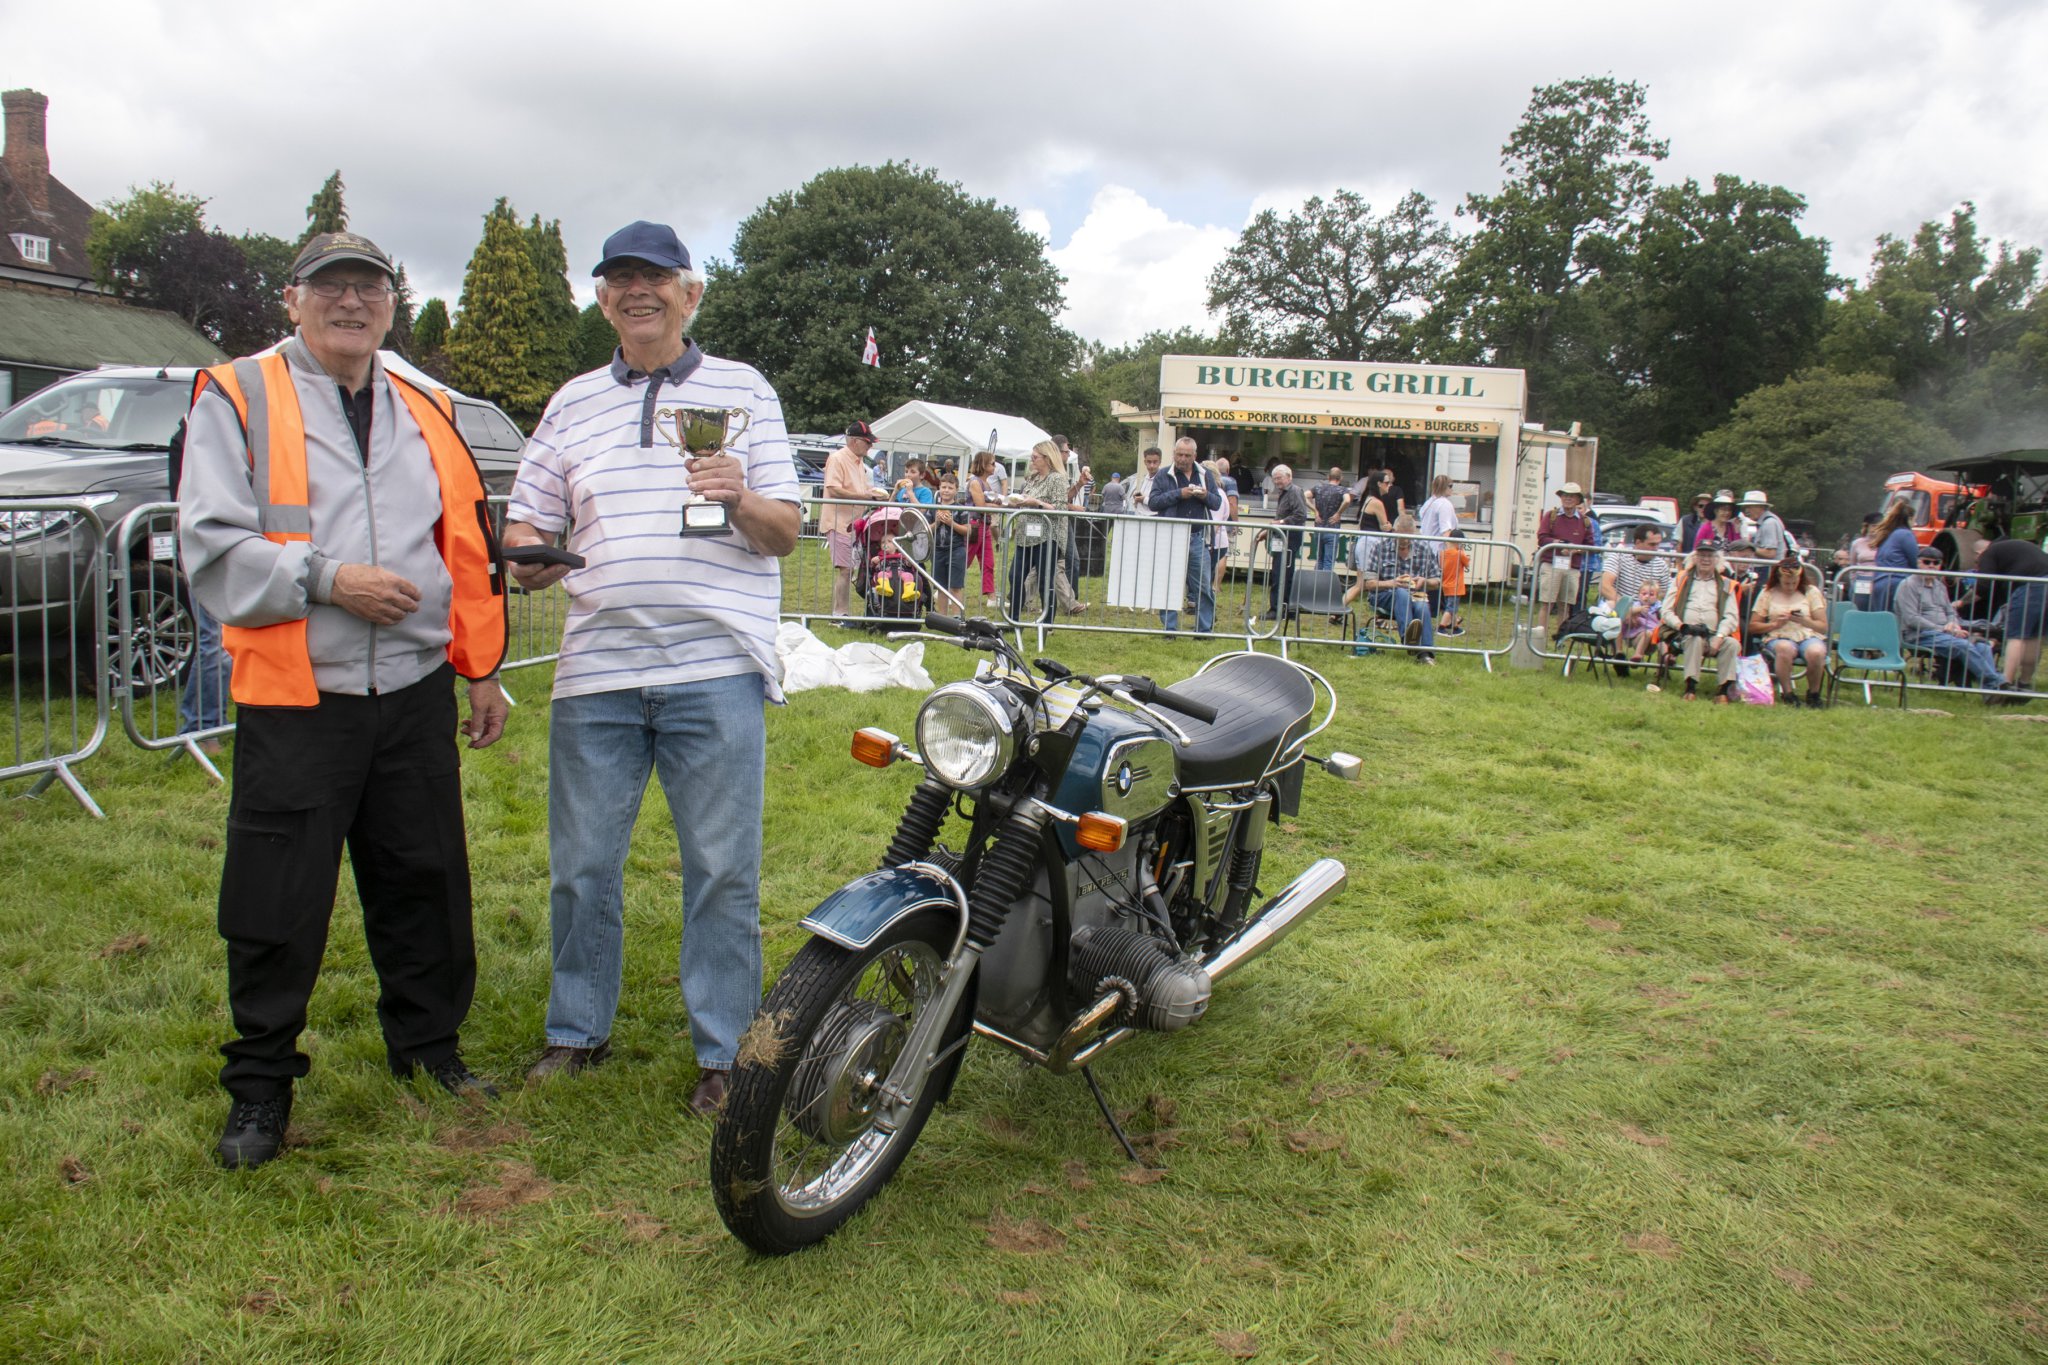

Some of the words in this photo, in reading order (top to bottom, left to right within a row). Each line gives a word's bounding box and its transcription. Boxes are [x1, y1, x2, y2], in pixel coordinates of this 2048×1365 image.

[1196, 365, 1354, 391] BURGER
[1366, 372, 1485, 398] GRILL
[1178, 408, 1201, 419] HOT
[1204, 409, 1235, 421] DOGS
[1247, 412, 1279, 423] PORK
[1281, 414, 1317, 425] ROLLS
[1331, 416, 1371, 427] BACON
[1374, 418, 1411, 430] ROLLS
[1424, 420, 1480, 432] BURGERS
